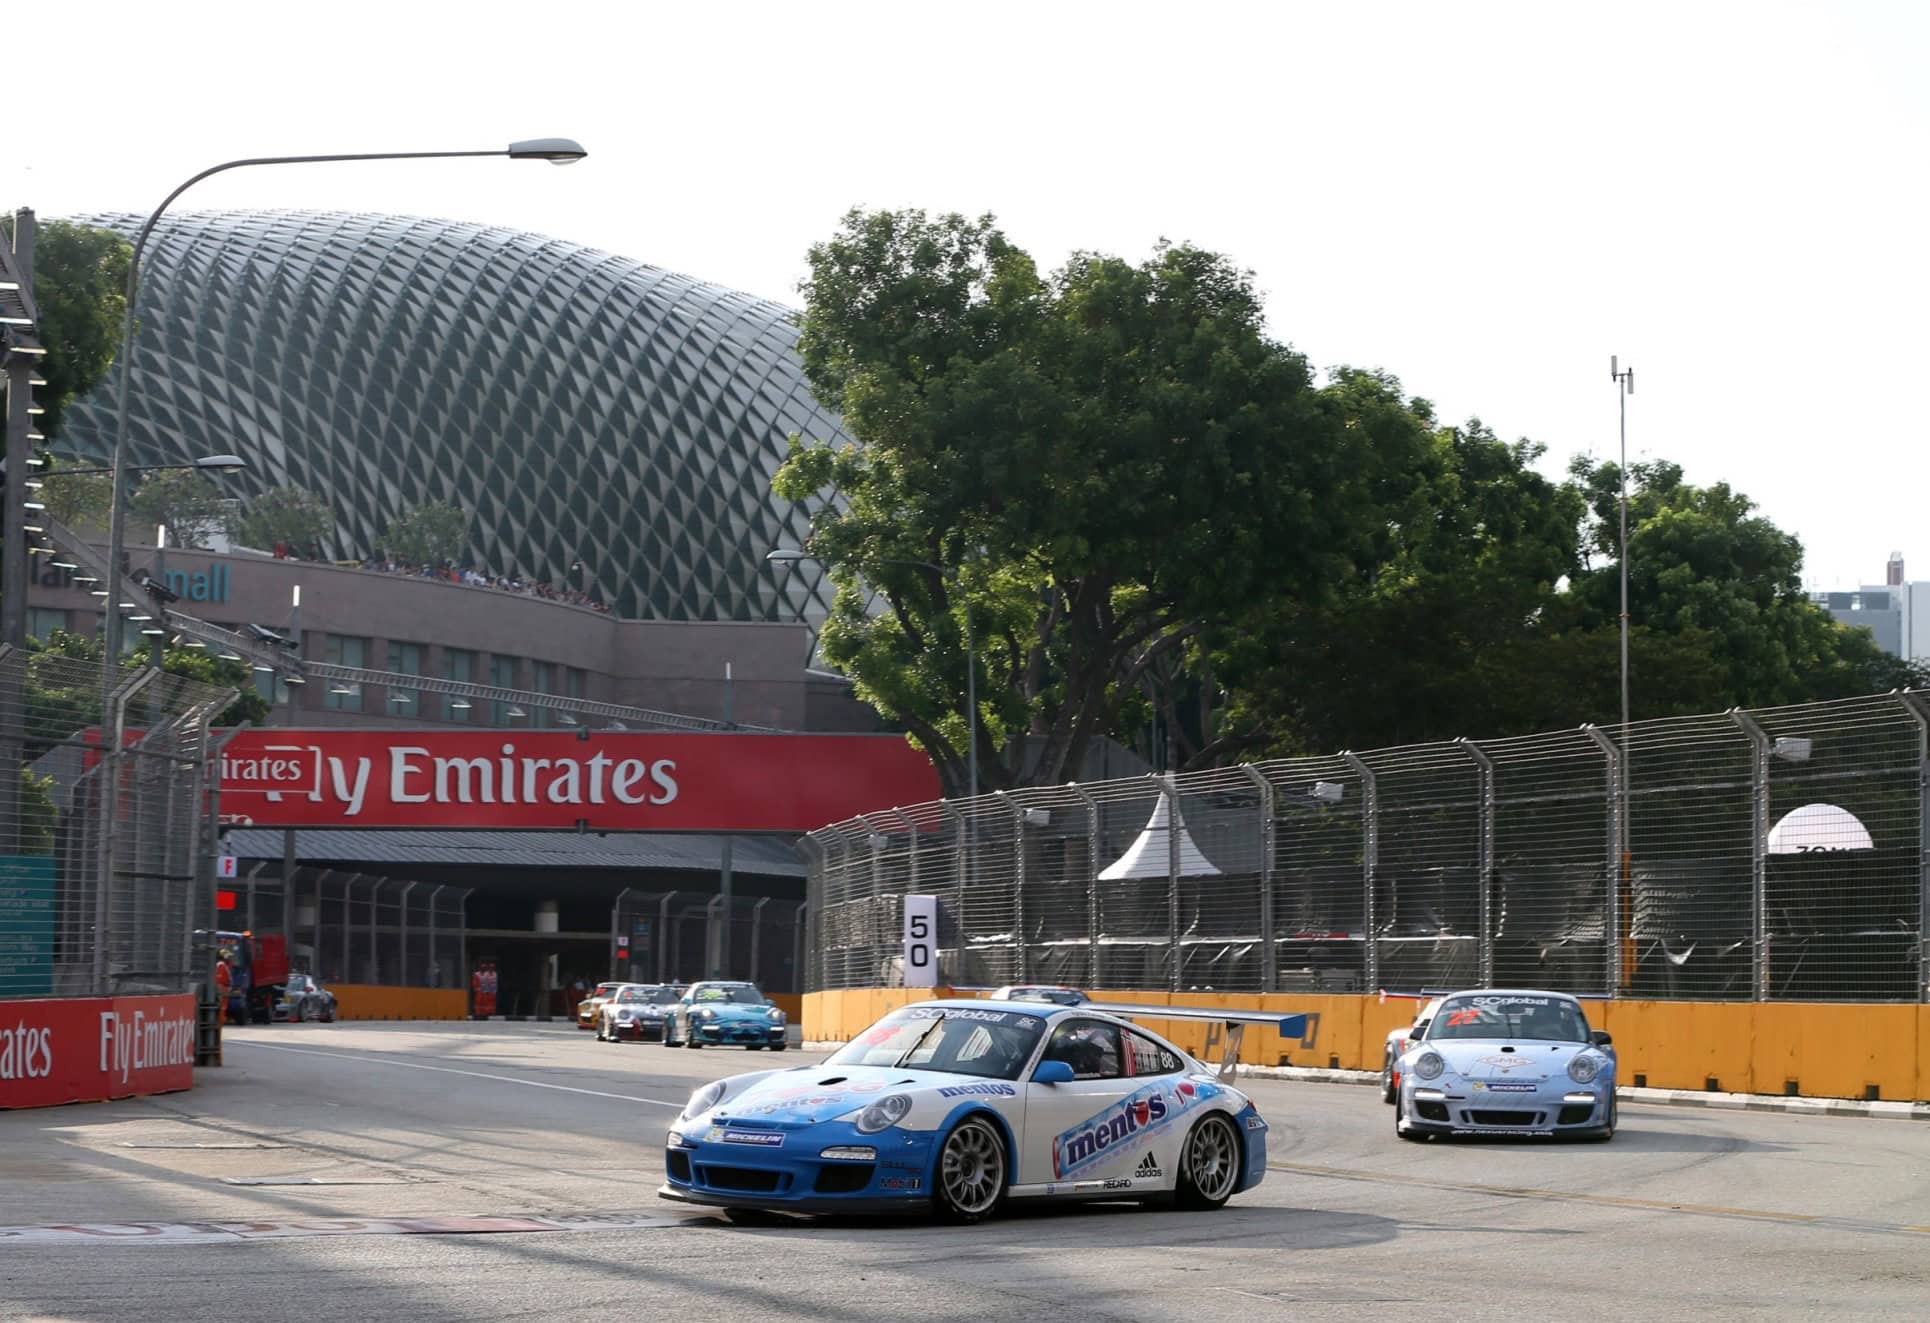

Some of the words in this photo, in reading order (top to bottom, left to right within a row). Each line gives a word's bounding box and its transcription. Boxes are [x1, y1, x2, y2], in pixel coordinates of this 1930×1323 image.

[204, 752, 302, 781] irates
[389, 743, 679, 805] Emirates
[0, 1018, 52, 1079] ates
[100, 1010, 131, 1084] Fly
[1159, 1051, 1175, 1070] 88
[937, 1083, 1017, 1098] mentos
[725, 1132, 782, 1143] MICHELIN
[1066, 1093, 1168, 1167] mentos
[1103, 1179, 1132, 1189] RECARO
[1134, 1167, 1163, 1179] adidas
